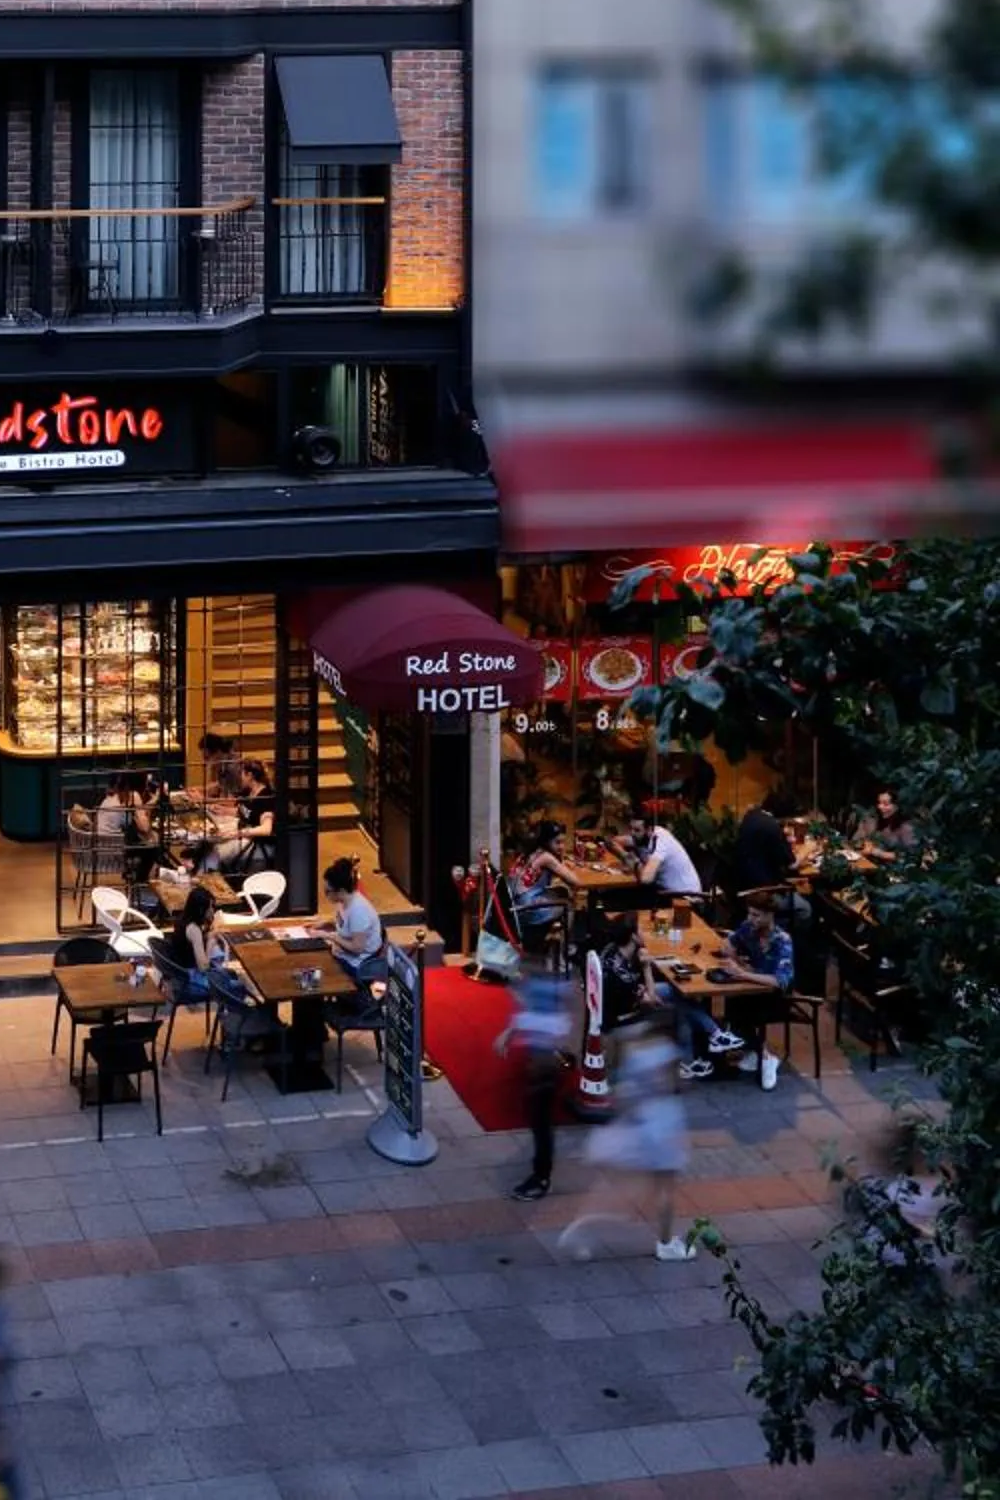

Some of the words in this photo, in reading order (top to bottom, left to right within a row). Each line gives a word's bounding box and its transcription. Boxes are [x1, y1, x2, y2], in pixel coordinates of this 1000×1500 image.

[19, 457, 65, 469] Bistro
[75, 452, 120, 466] Hotel
[313, 651, 347, 698] HOTEL
[406, 651, 450, 676] Red
[459, 652, 517, 674] Stone
[417, 684, 512, 712] HOTEL
